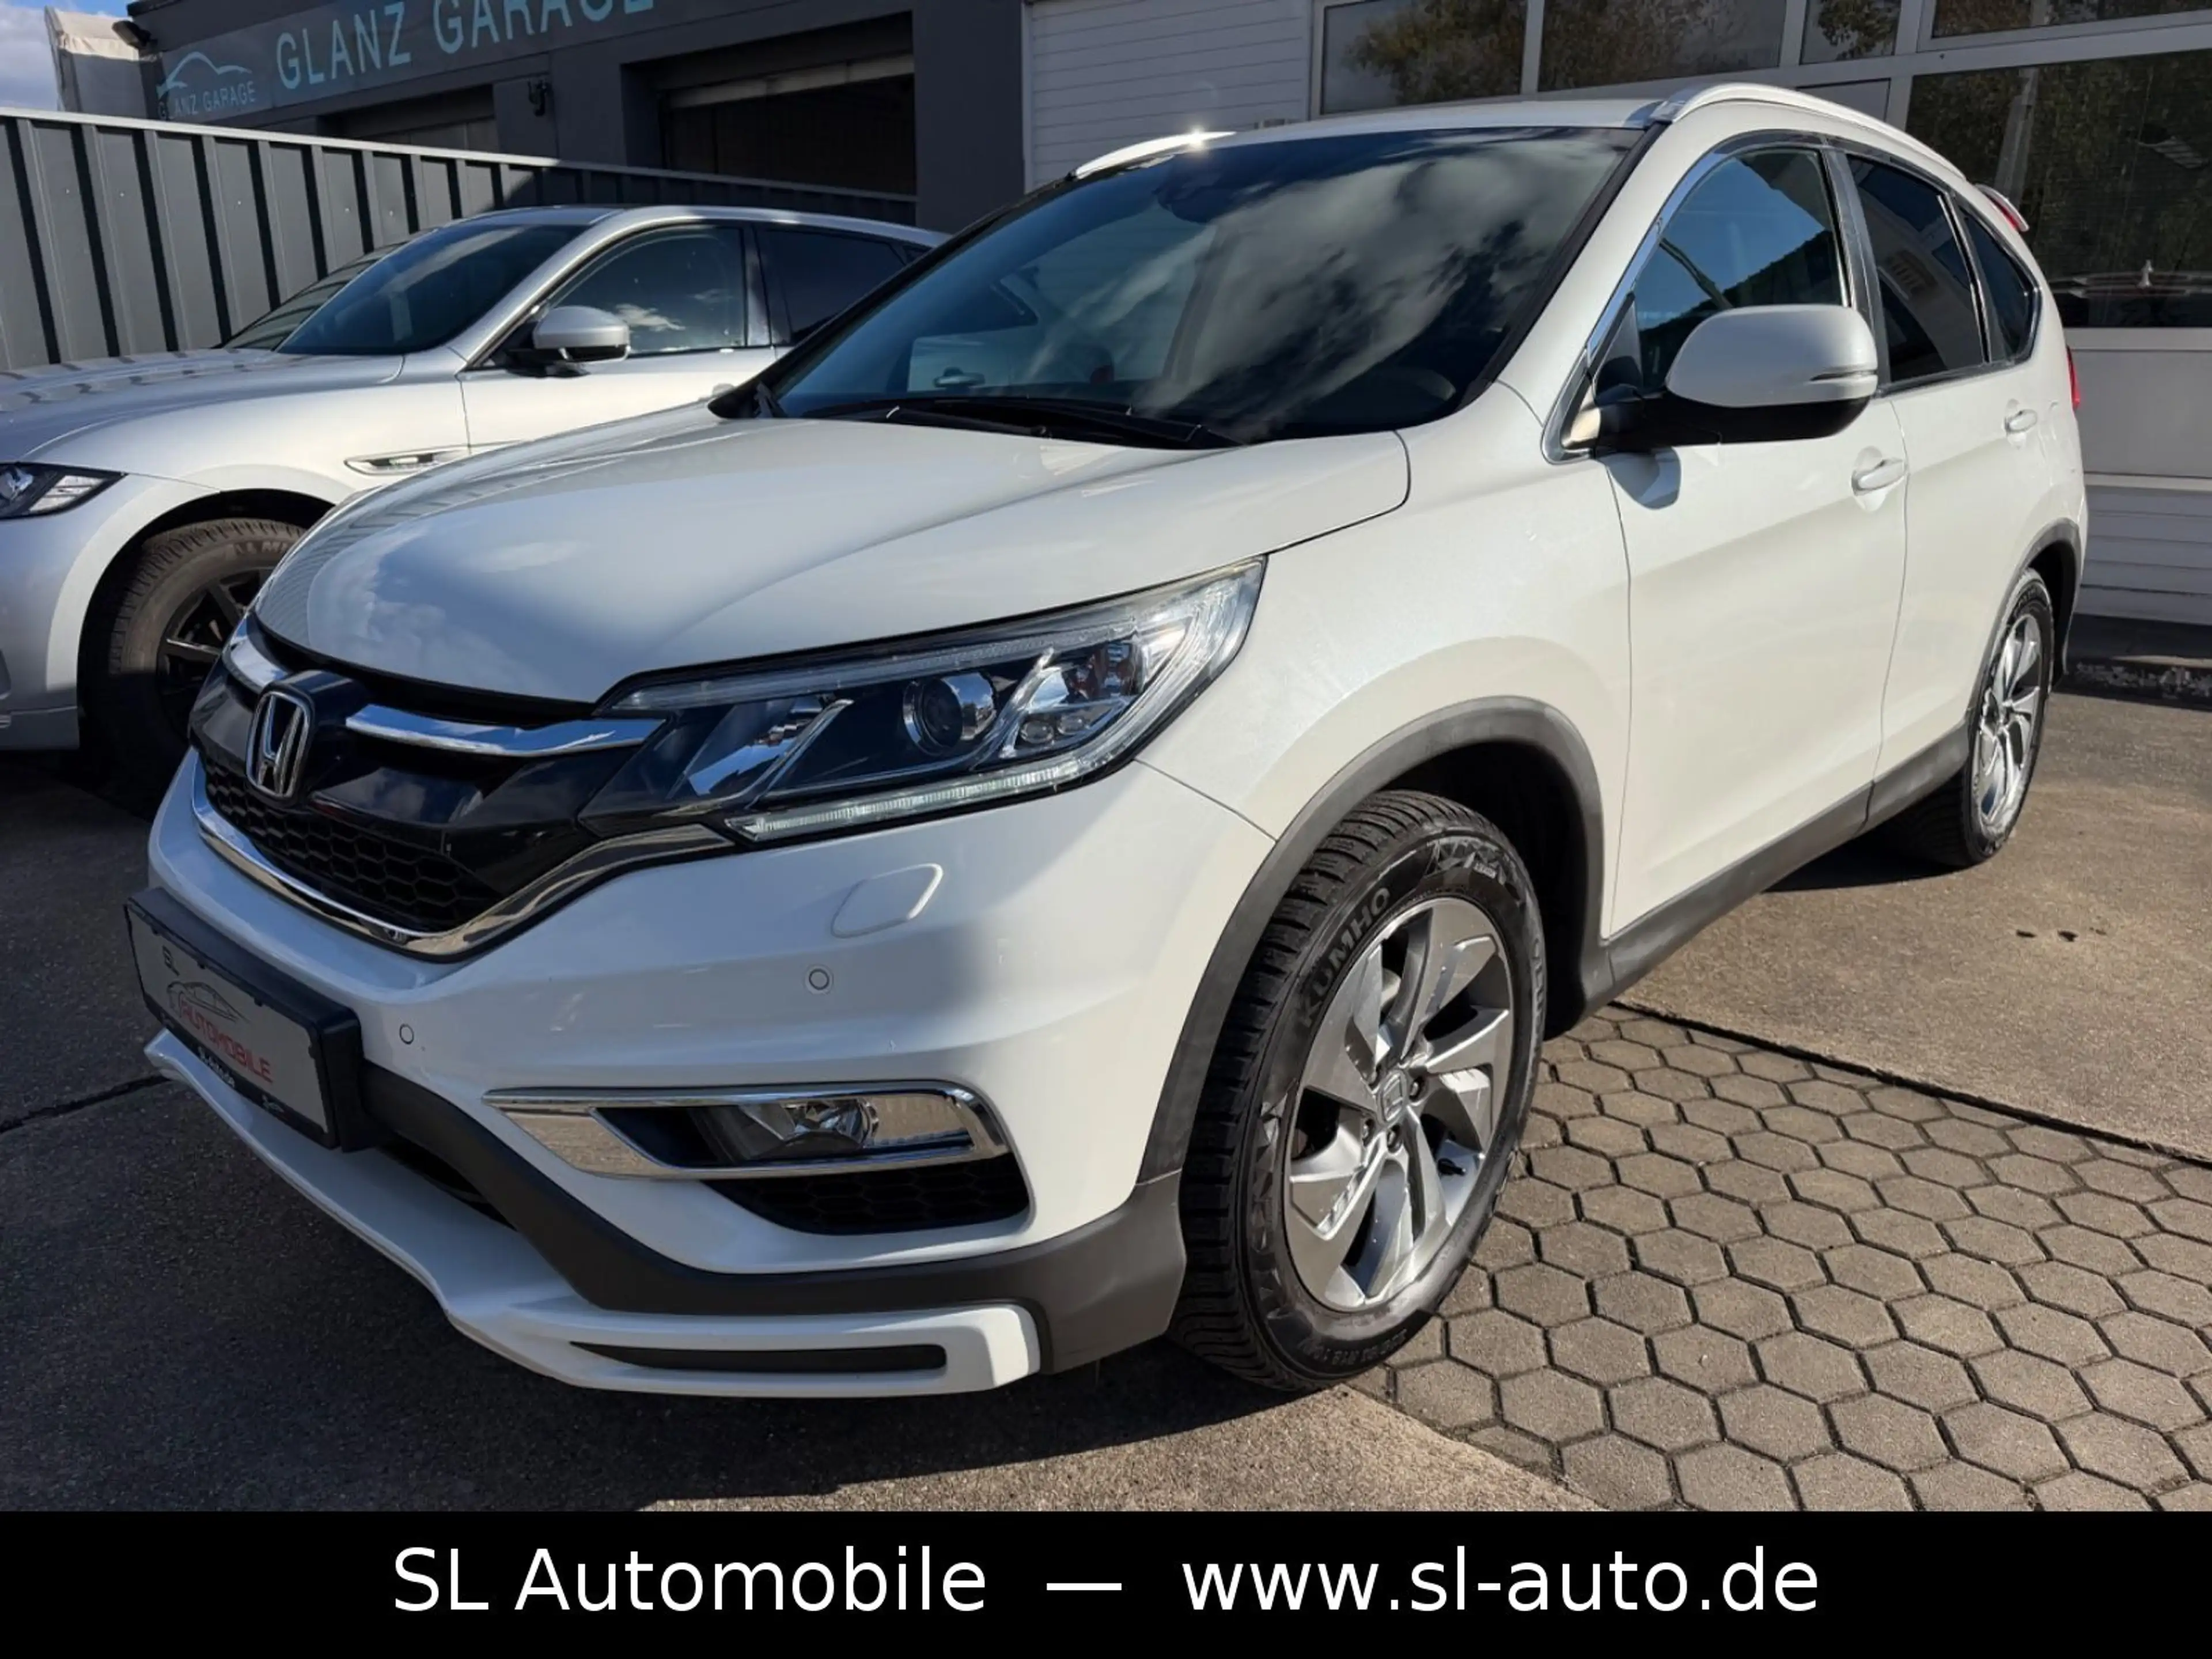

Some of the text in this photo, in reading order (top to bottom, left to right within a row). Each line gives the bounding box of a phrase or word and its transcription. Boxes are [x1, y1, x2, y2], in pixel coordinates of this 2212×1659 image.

[276, 0, 654, 89] GLANZ GARA
[203, 81, 256, 112] GARAGE
[1300, 888, 1390, 1028] KUMHO
[180, 998, 274, 1084] AUTOMOBILE
